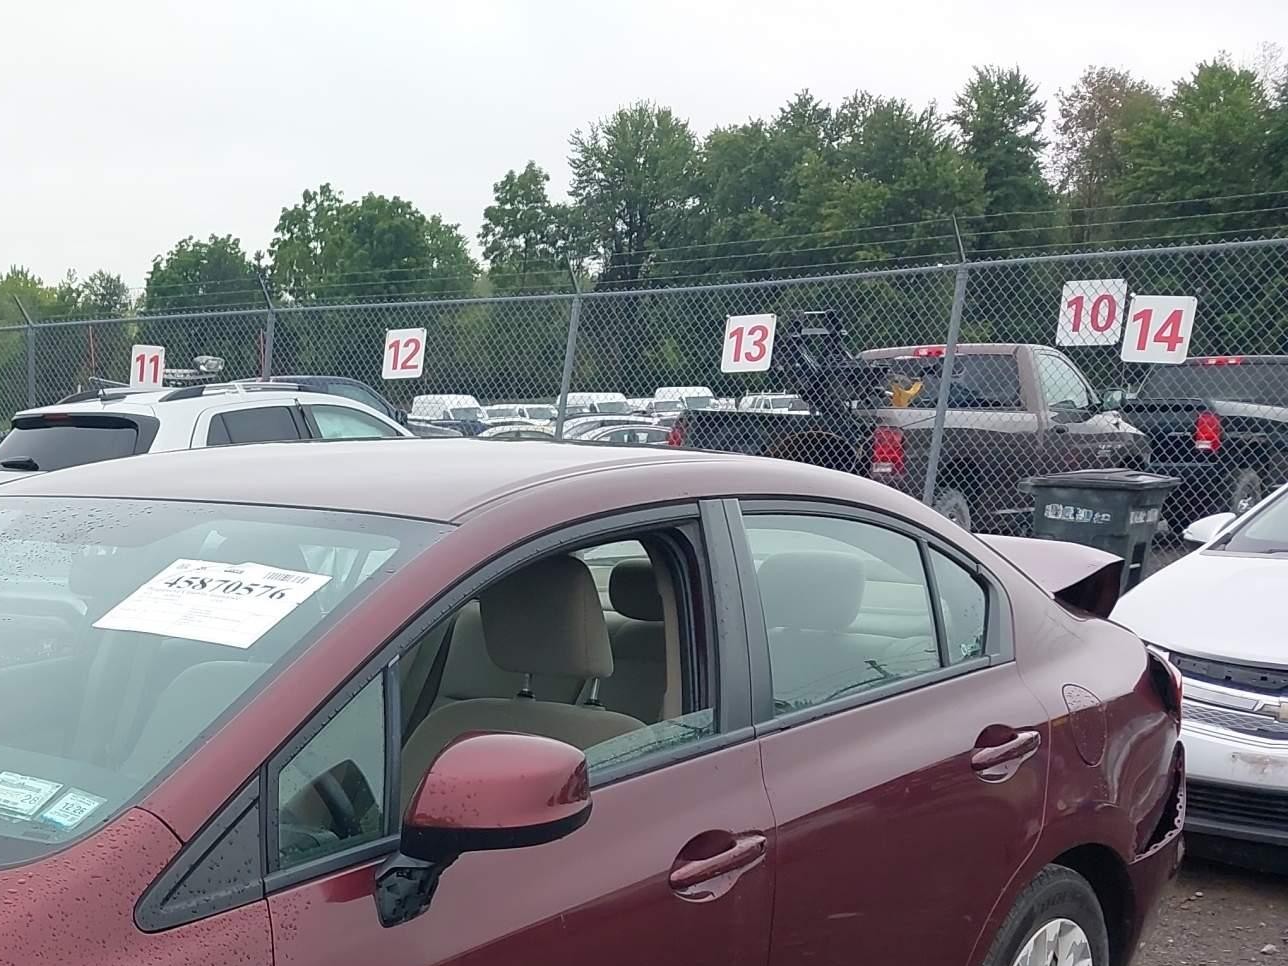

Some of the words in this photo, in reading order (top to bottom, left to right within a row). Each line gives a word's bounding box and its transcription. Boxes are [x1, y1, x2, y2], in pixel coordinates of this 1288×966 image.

[1066, 294, 1117, 333] 10
[1132, 308, 1184, 352] 14
[388, 338, 421, 371] 12
[728, 324, 769, 363] 13
[135, 353, 160, 384] 11
[164, 575, 293, 601] 45870576
[62, 801, 74, 811] 12
